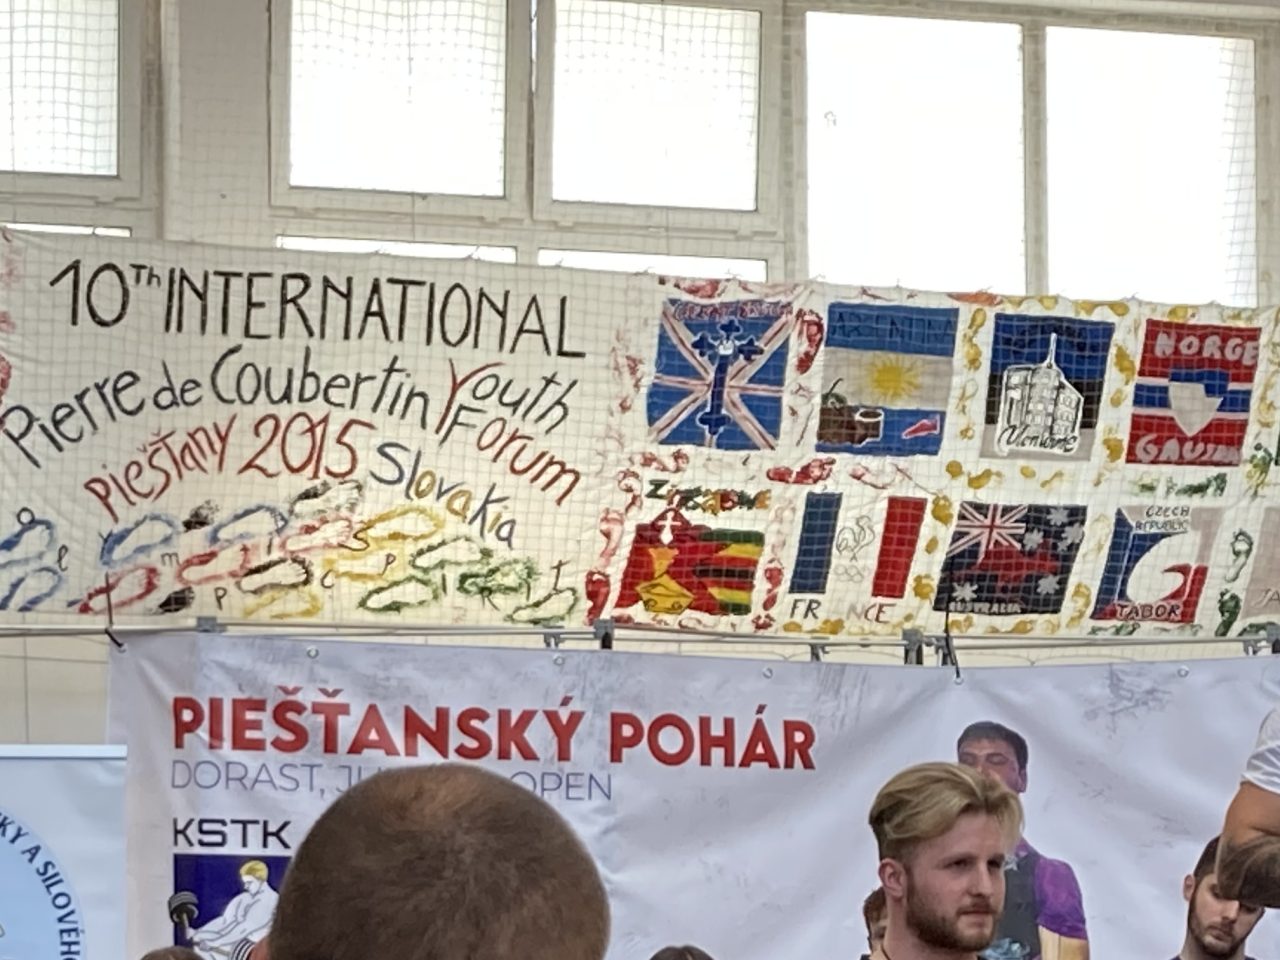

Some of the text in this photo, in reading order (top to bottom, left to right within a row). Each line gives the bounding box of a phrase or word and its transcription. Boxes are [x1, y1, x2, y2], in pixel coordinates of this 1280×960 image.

[164, 267, 586, 358] INTERNATIONAL
[1154, 331, 1259, 366] NORGE
[2, 343, 579, 468] Pierre de Coubertin Youth
[238, 410, 377, 481] 2015
[438, 403, 581, 507] Forum
[1146, 506, 1190, 518] CZECH
[1116, 604, 1181, 618] TABOR
[172, 686, 818, 771] PIEŠŤANSKÝ POHÁR
[170, 760, 327, 800] DORAST,
[172, 817, 293, 850] KSTK
[20, 844, 42, 864] A
